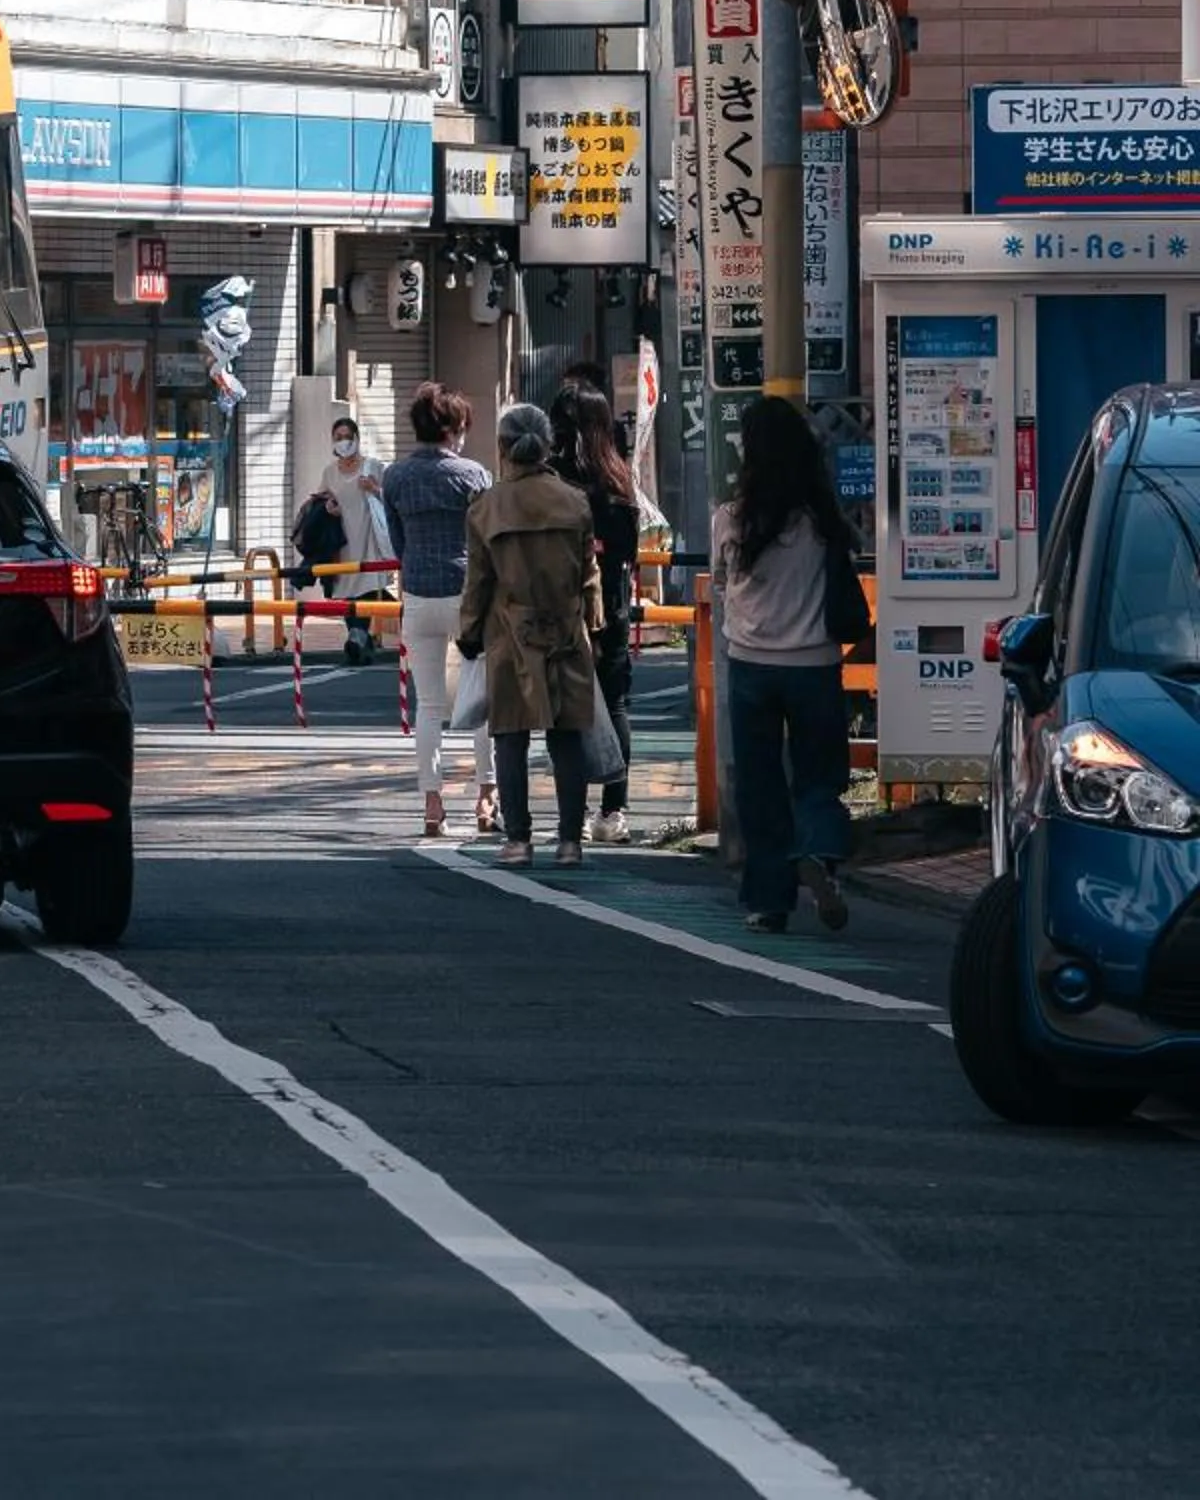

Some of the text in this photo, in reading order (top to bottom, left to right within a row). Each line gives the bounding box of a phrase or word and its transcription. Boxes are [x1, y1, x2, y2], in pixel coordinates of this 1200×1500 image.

[999, 96, 1200, 124] 下北沢エリアのお
[20, 112, 112, 168] LAWSON
[1024, 135, 1195, 163] 学生さんも安心
[717, 75, 763, 241] きくや
[889, 233, 933, 249] DNP
[127, 620, 181, 639] しばらく
[919, 660, 974, 679] DNP
